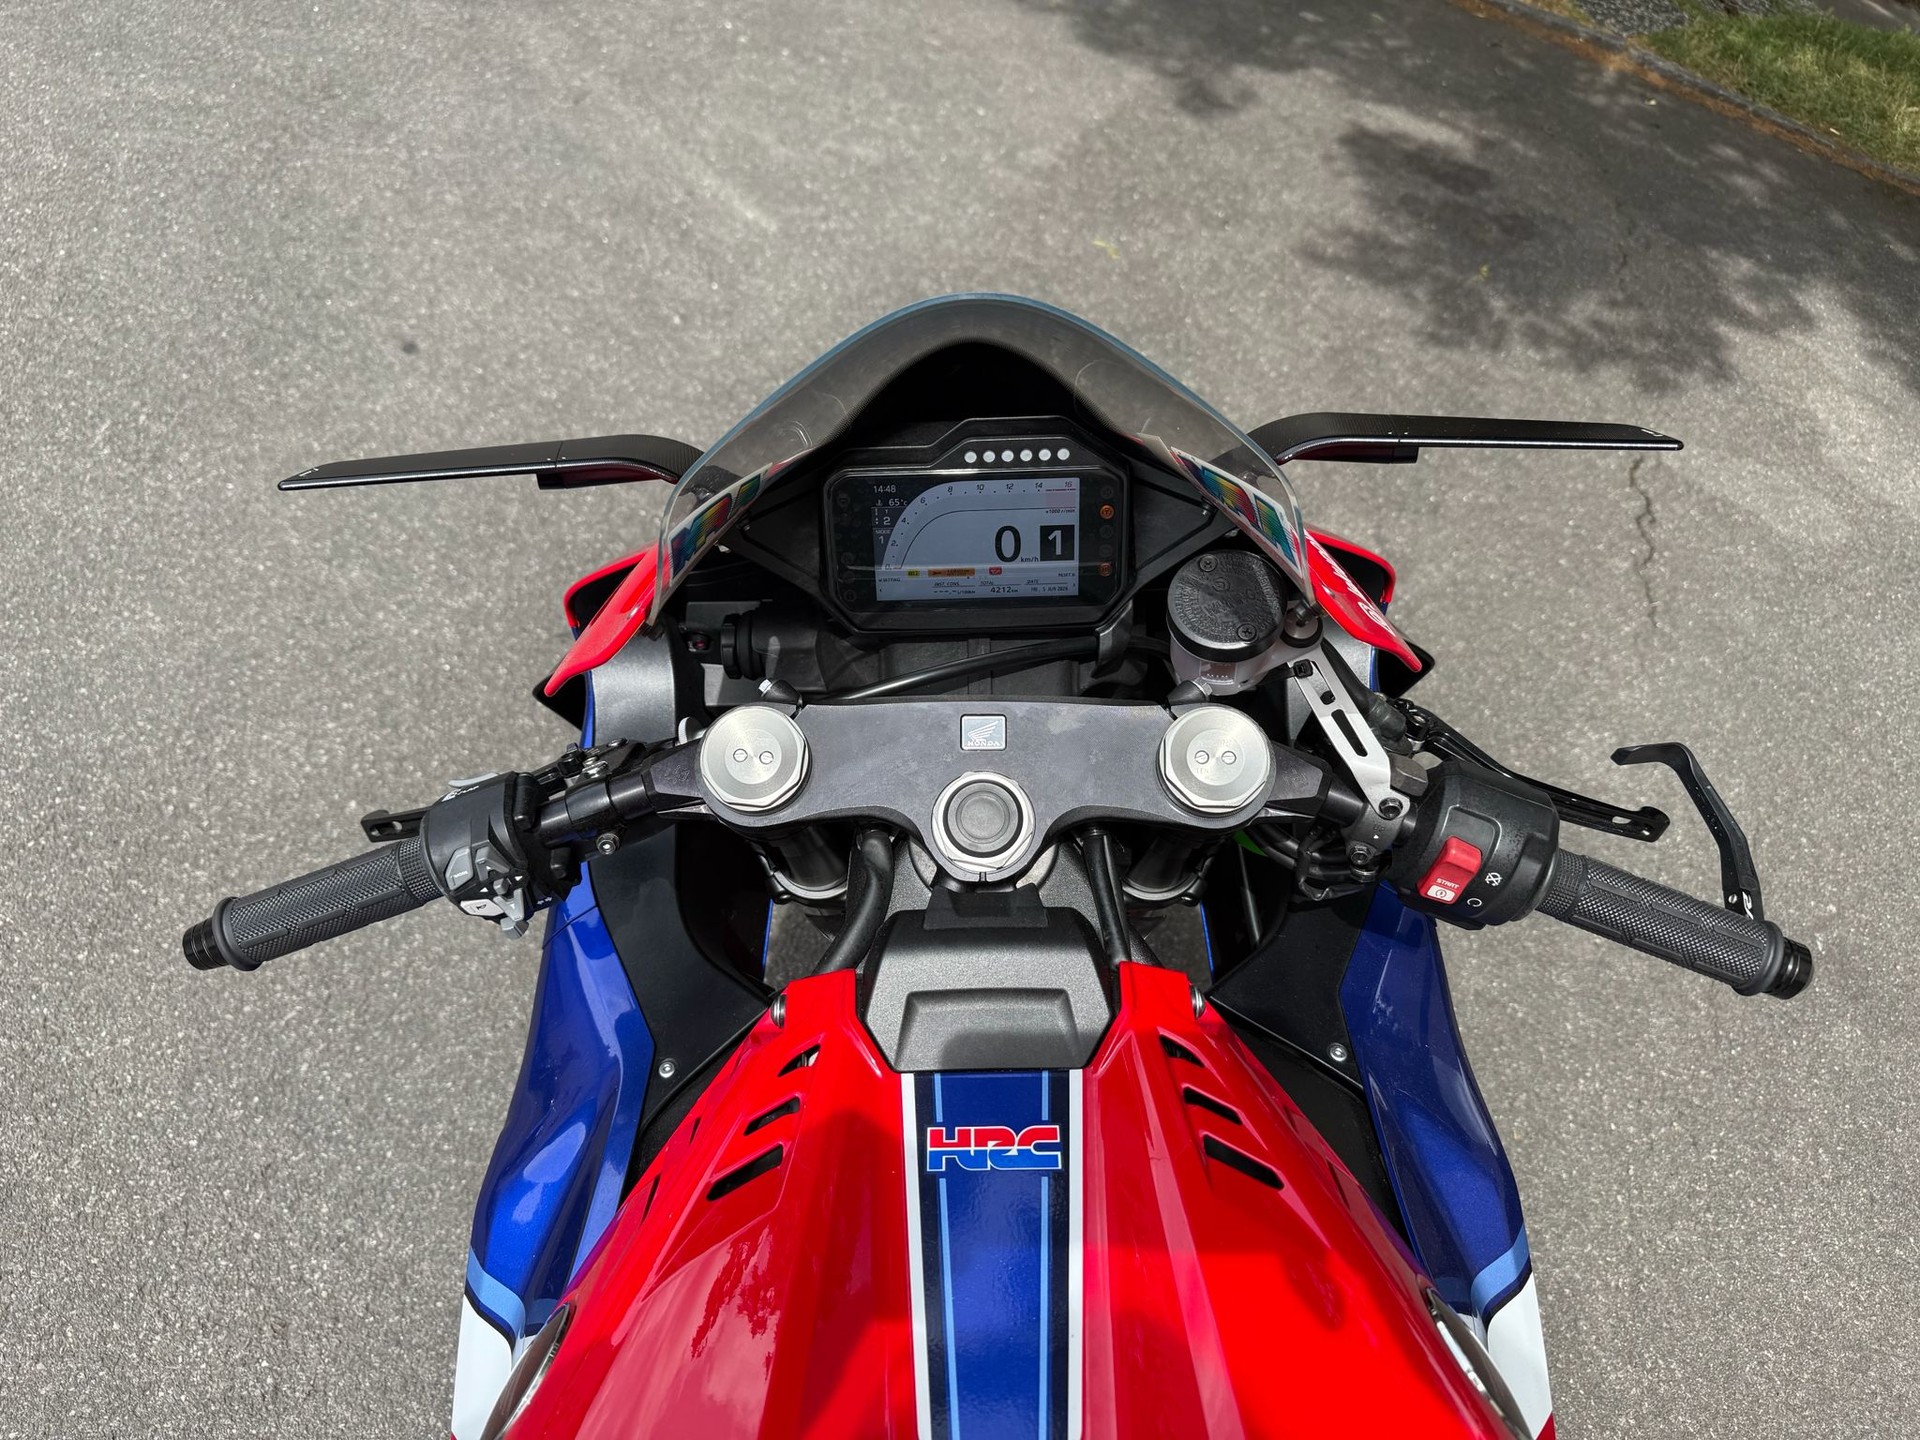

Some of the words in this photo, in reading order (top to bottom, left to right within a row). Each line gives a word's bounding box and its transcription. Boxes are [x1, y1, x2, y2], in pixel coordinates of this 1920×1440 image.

[873, 484, 897, 494] 14:48
[920, 496, 926, 504] 6
[883, 516, 891, 526] 2
[878, 535, 885, 545] 1
[994, 525, 1022, 563] 0
[1047, 529, 1062, 556] 1
[1435, 877, 1460, 890] START
[926, 1125, 1062, 1172] HRC
